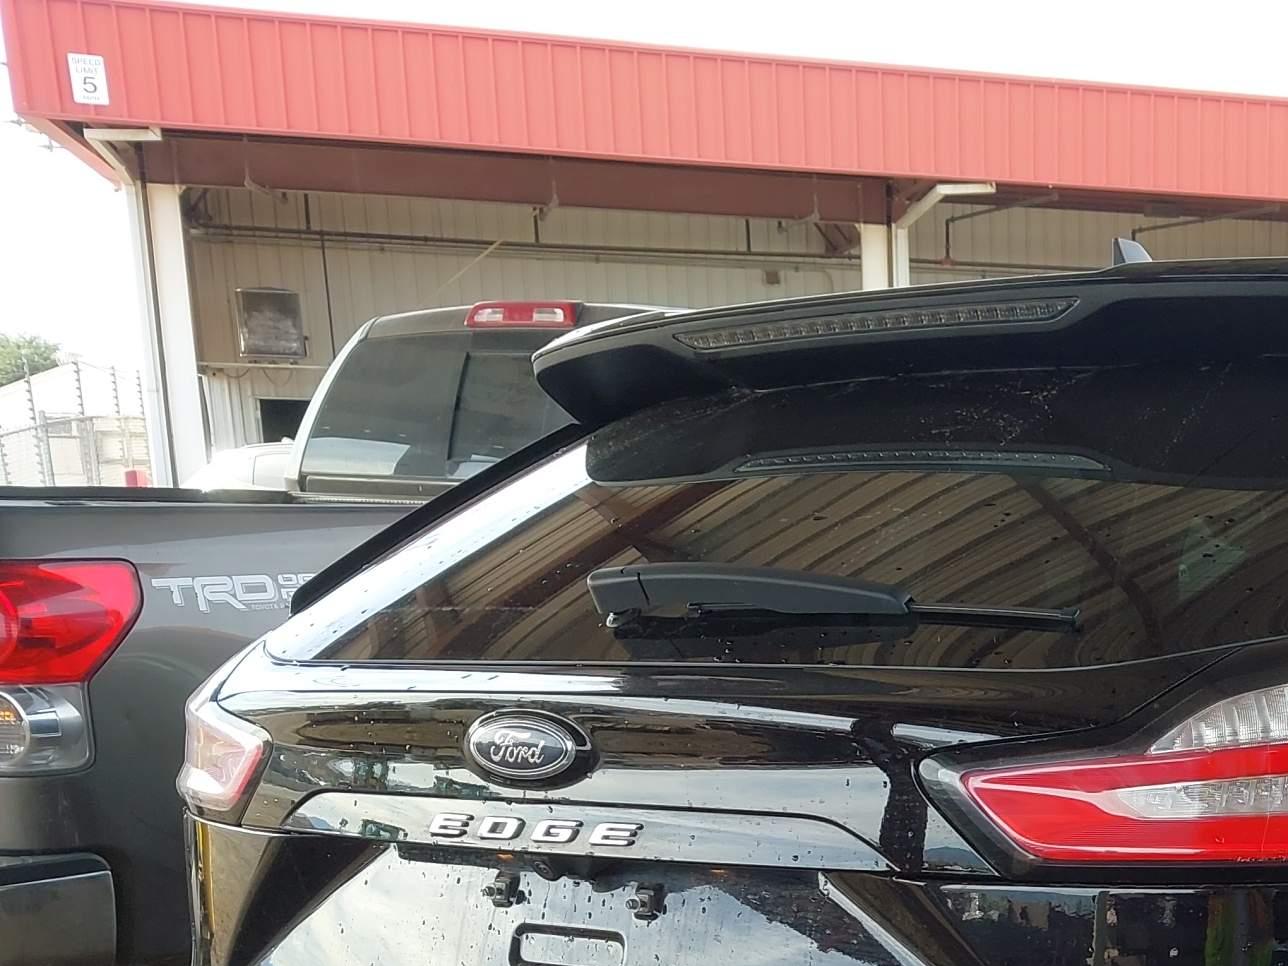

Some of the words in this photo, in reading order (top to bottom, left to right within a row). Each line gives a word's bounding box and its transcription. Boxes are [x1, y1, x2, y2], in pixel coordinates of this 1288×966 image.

[83, 76, 97, 93] 5
[151, 574, 277, 614] TRD
[490, 730, 546, 764] Ford
[428, 812, 645, 847] EDGE
